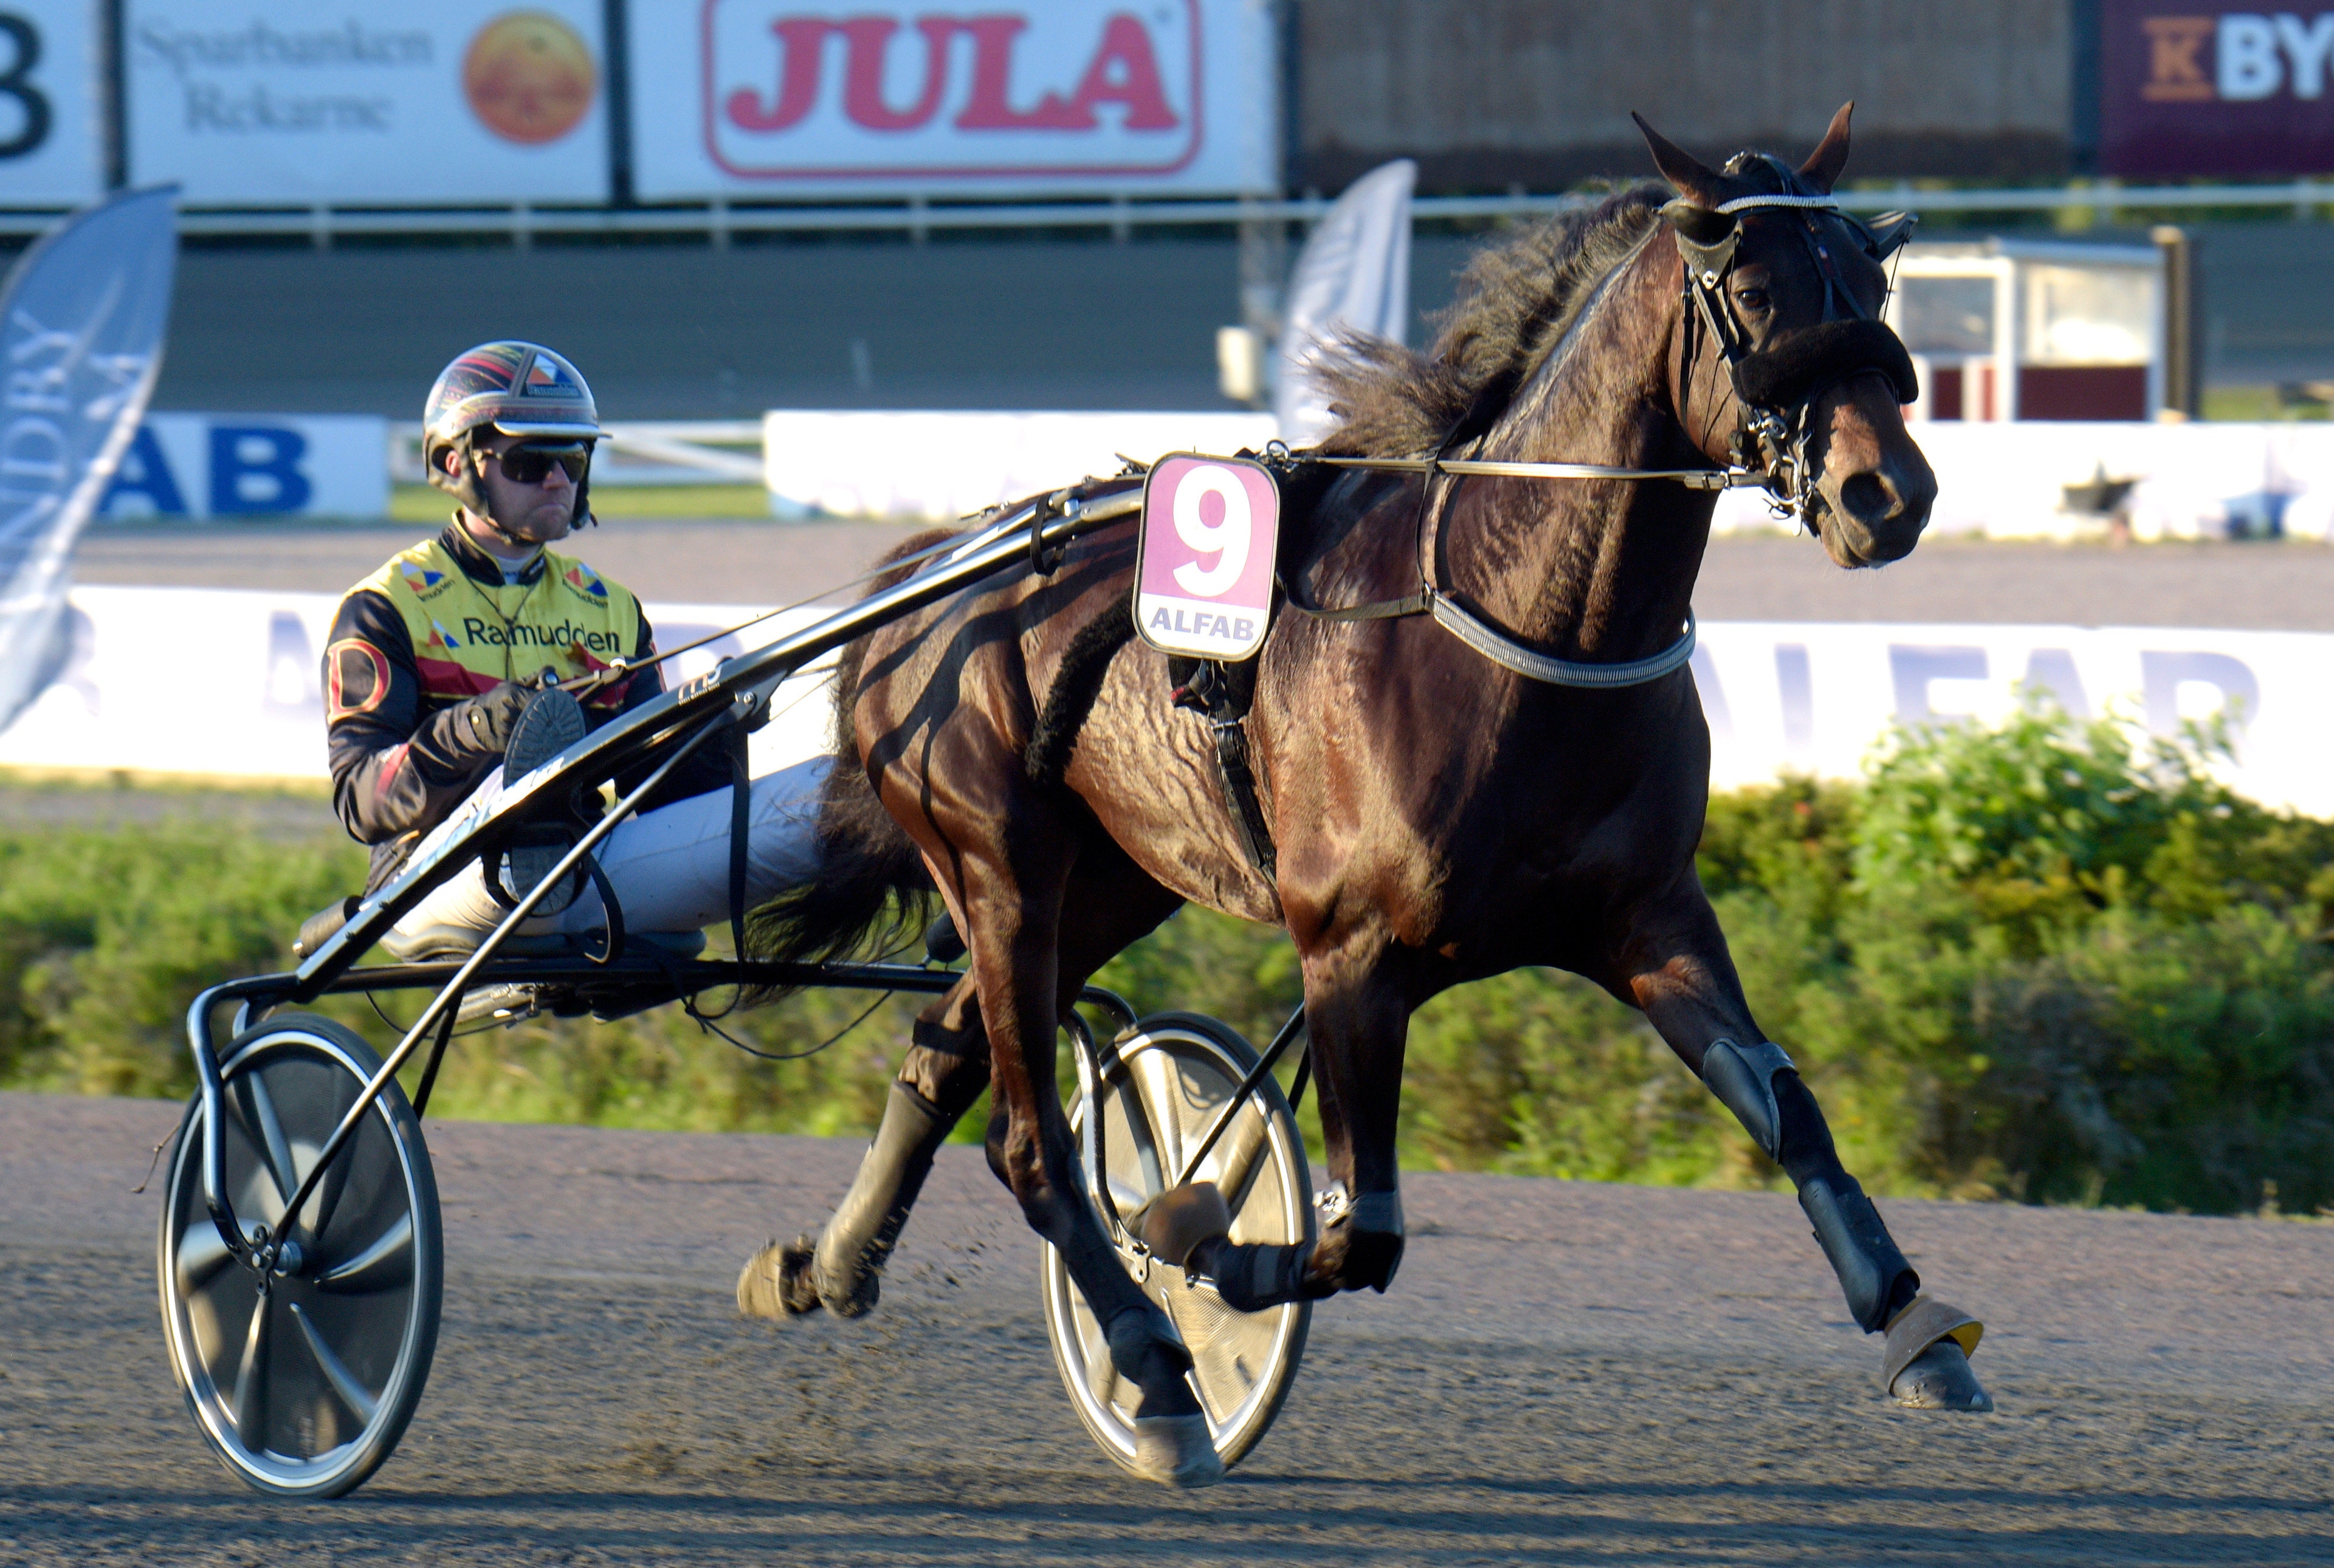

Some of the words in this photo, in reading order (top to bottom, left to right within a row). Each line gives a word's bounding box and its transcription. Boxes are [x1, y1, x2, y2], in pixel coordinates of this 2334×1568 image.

[725, 12, 1180, 134] JULA
[1172, 465, 1251, 597] 9
[463, 616, 620, 653] Ramudden
[1149, 607, 1255, 641] ALFAB
[327, 638, 391, 724] D
